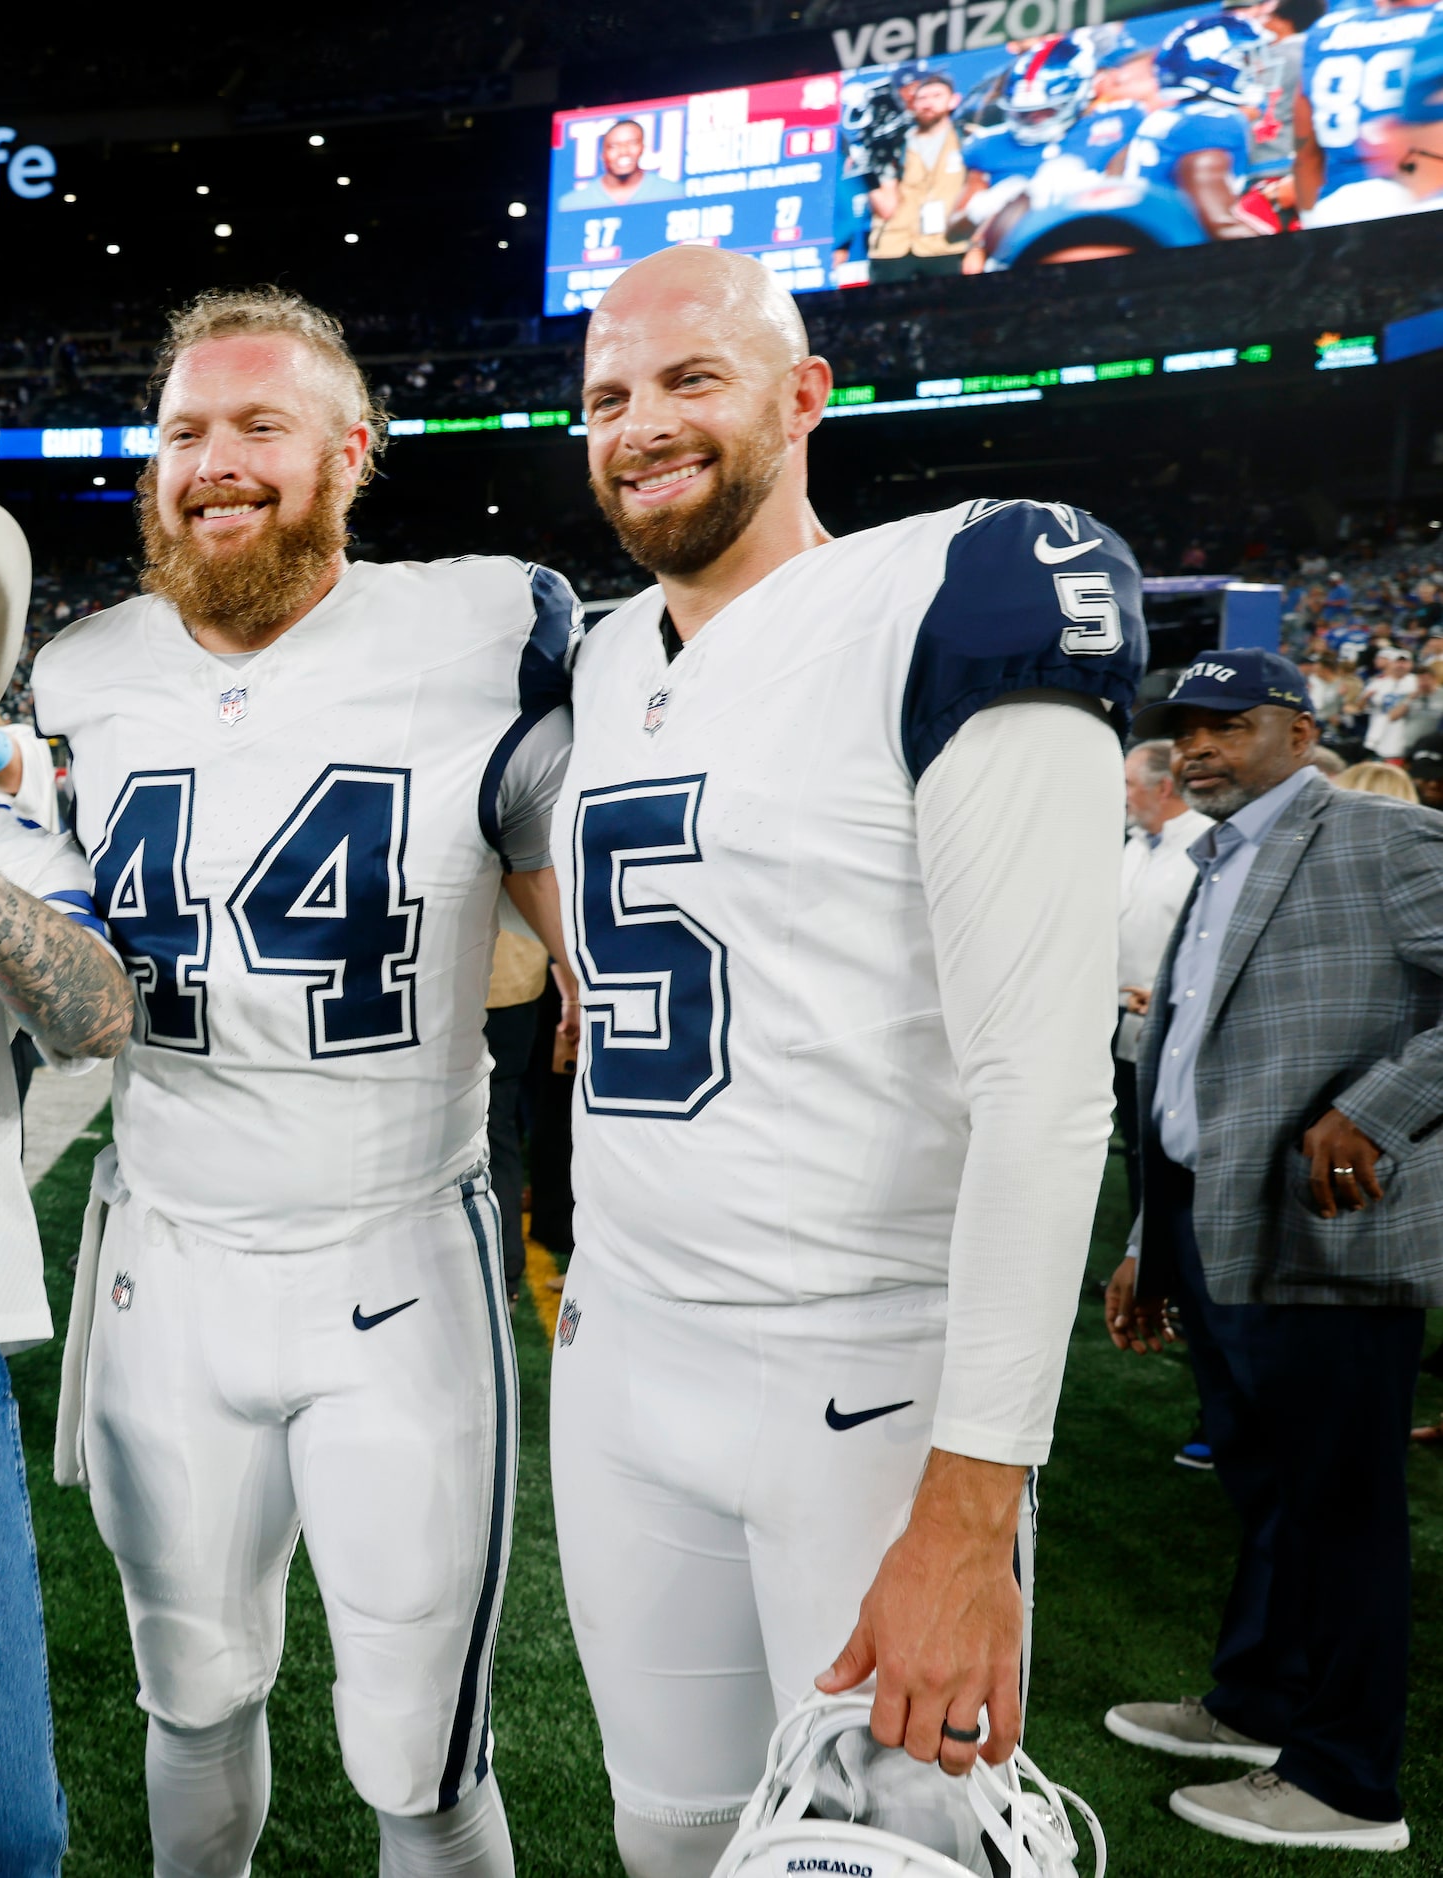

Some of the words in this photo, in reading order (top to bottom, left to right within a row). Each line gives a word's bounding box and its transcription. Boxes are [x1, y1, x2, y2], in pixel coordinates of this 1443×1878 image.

[832, 0, 1104, 69] verizon
[1052, 571, 1125, 657] 5
[89, 763, 424, 1060] 44
[573, 772, 732, 1121] 5
